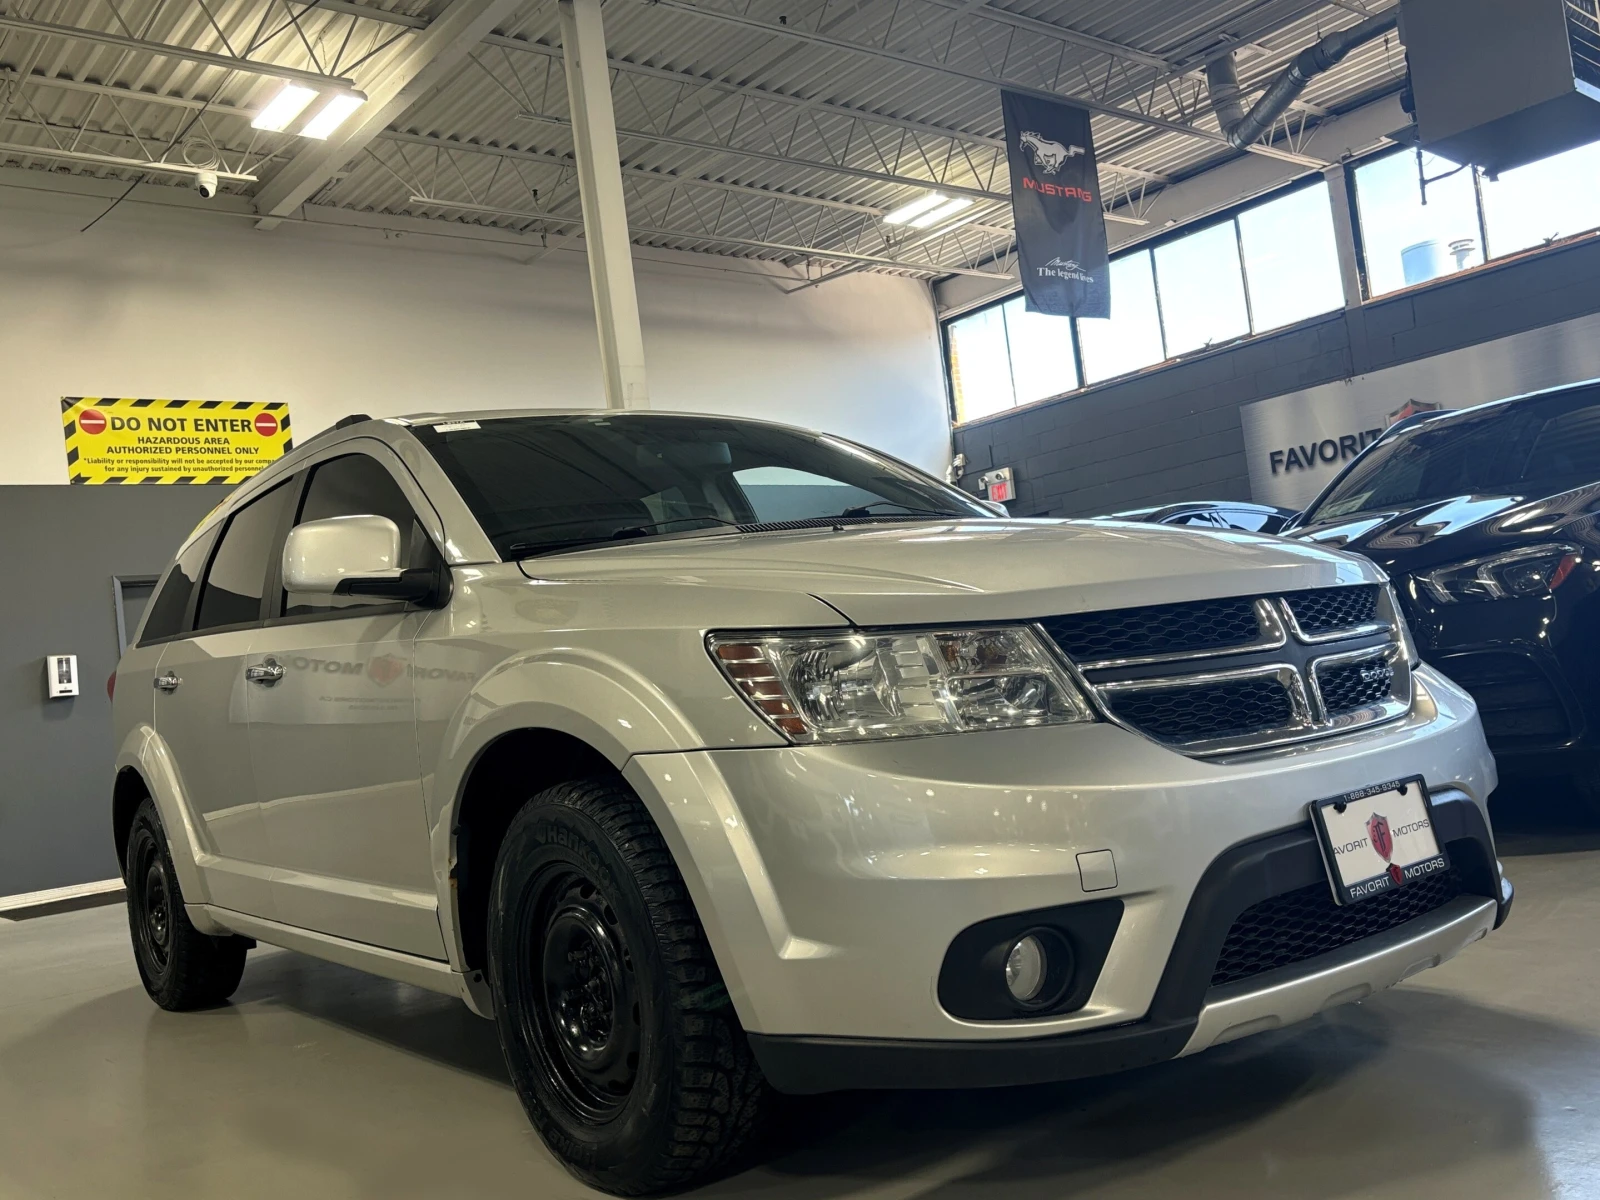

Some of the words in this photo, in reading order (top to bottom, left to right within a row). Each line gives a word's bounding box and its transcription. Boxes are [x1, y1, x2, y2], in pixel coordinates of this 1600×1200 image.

[1023, 177, 1092, 202] MUSTANG
[1037, 267, 1056, 277] The
[1057, 268, 1079, 280] legend
[111, 416, 141, 432] DO
[147, 418, 187, 432] NOT
[194, 419, 253, 433] ENTER
[137, 436, 201, 445] HAZARDOUS
[203, 437, 230, 445] AREA
[106, 446, 172, 454] AUTHORIZED
[235, 447, 259, 455] ONLY
[1269, 428, 1382, 474] FAVORIT
[234, 458, 243, 466] by
[1392, 819, 1430, 838] MOTORS
[1332, 838, 1368, 855] AVORIT
[1349, 876, 1390, 899] FAVORIT
[1404, 857, 1445, 879] MOTORS
